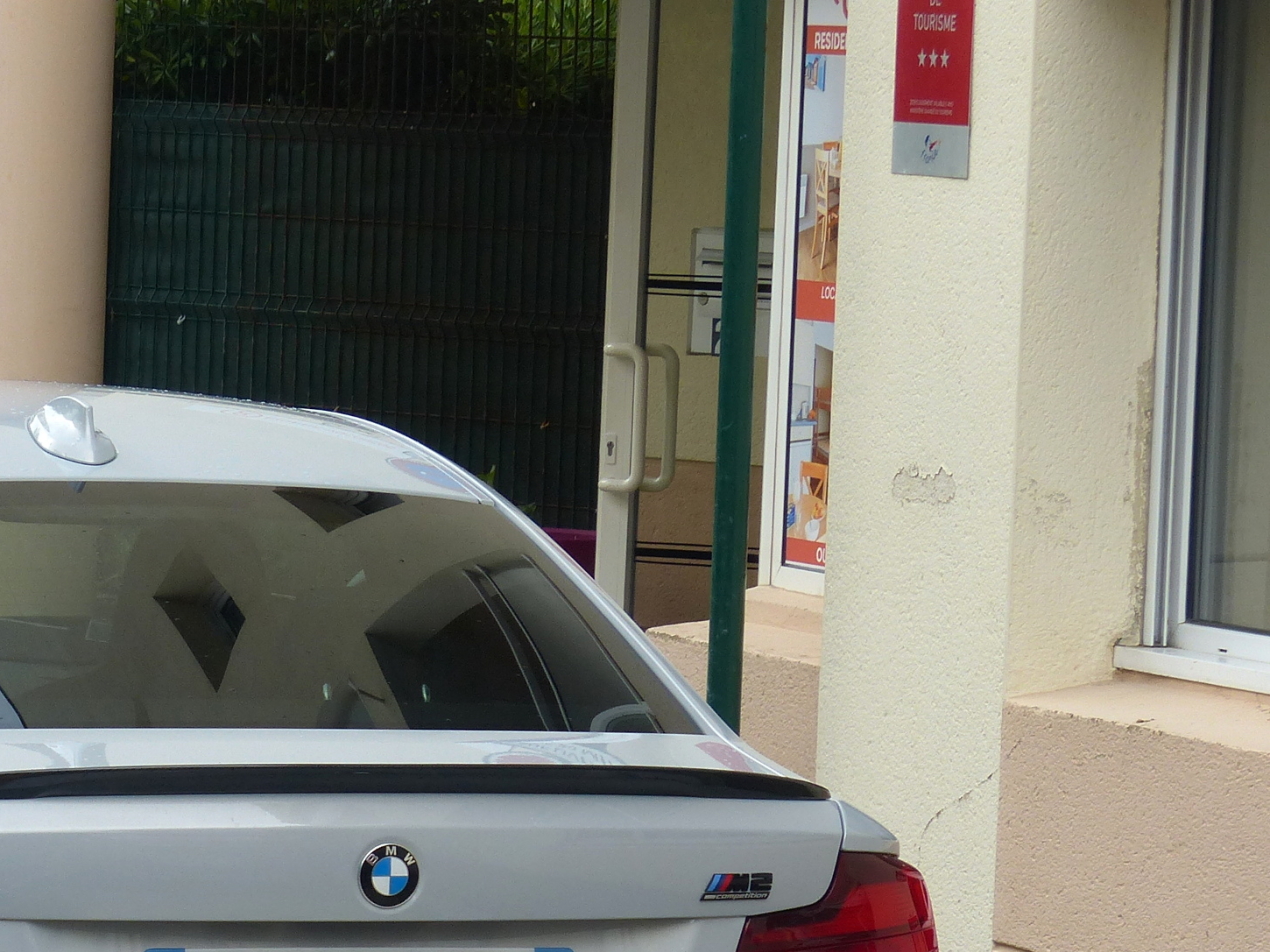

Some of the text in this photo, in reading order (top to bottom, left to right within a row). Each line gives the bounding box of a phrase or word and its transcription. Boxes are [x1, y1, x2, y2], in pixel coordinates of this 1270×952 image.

[913, 13, 957, 32] TOURISME
[366, 845, 416, 866] BMW
[724, 873, 773, 891] M2
[715, 892, 767, 900] competition
